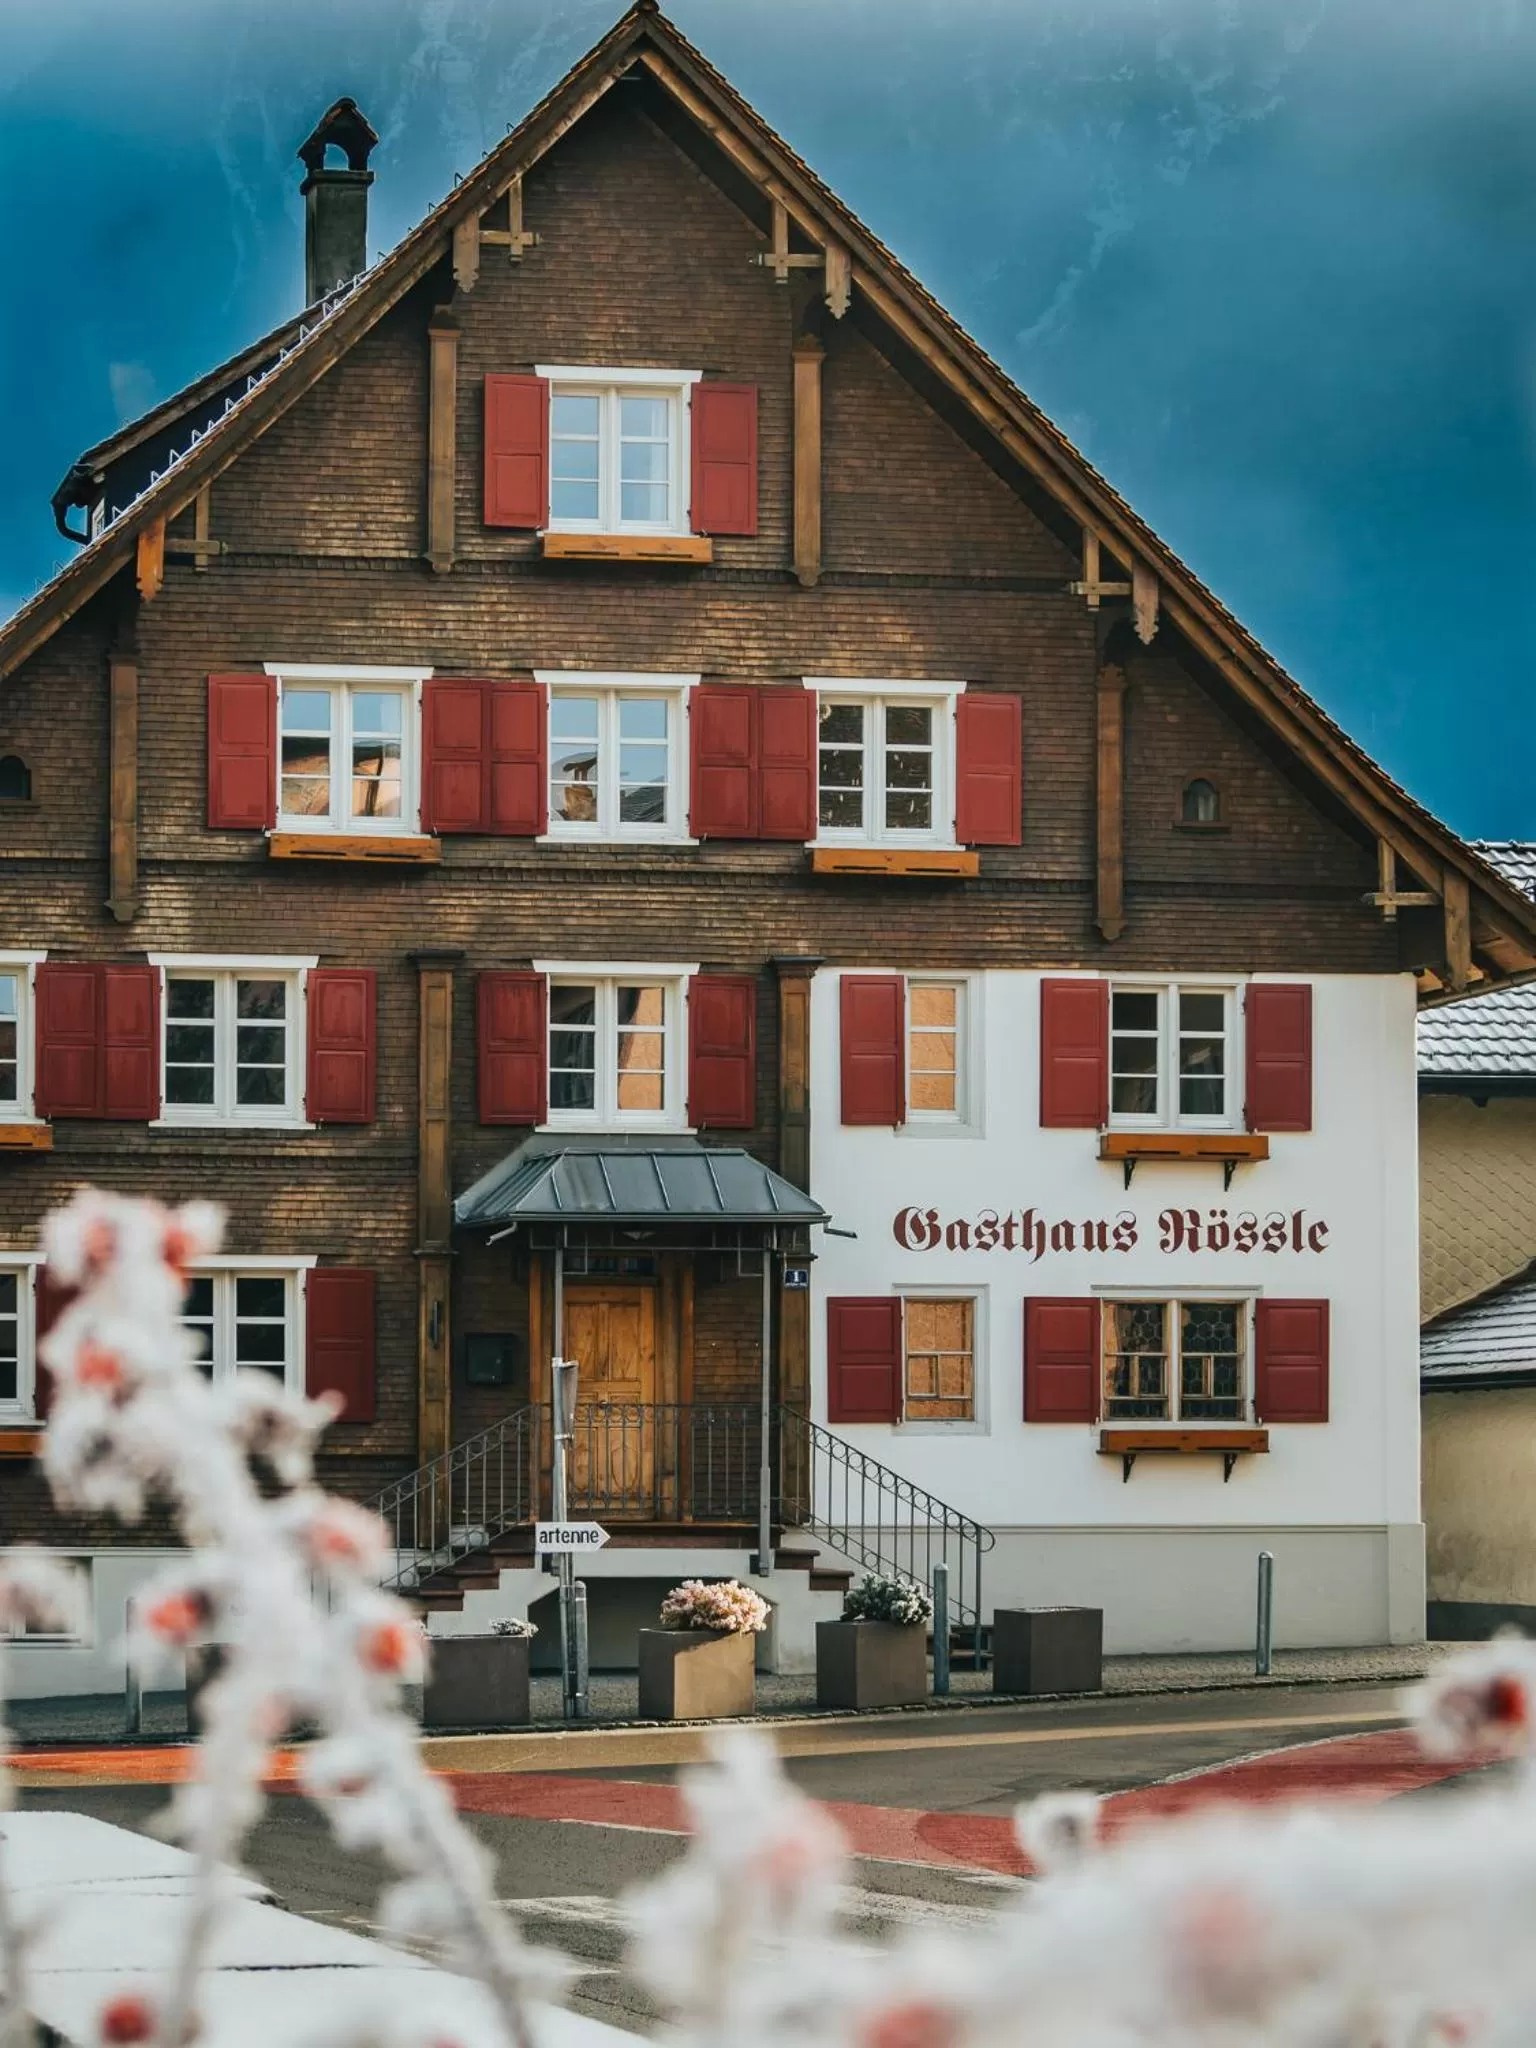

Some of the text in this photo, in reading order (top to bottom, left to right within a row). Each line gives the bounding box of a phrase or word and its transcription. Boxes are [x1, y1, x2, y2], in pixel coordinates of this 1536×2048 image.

[893, 1206, 1330, 1264] Gasthaus Rössle
[539, 1528, 599, 1544] artenne
